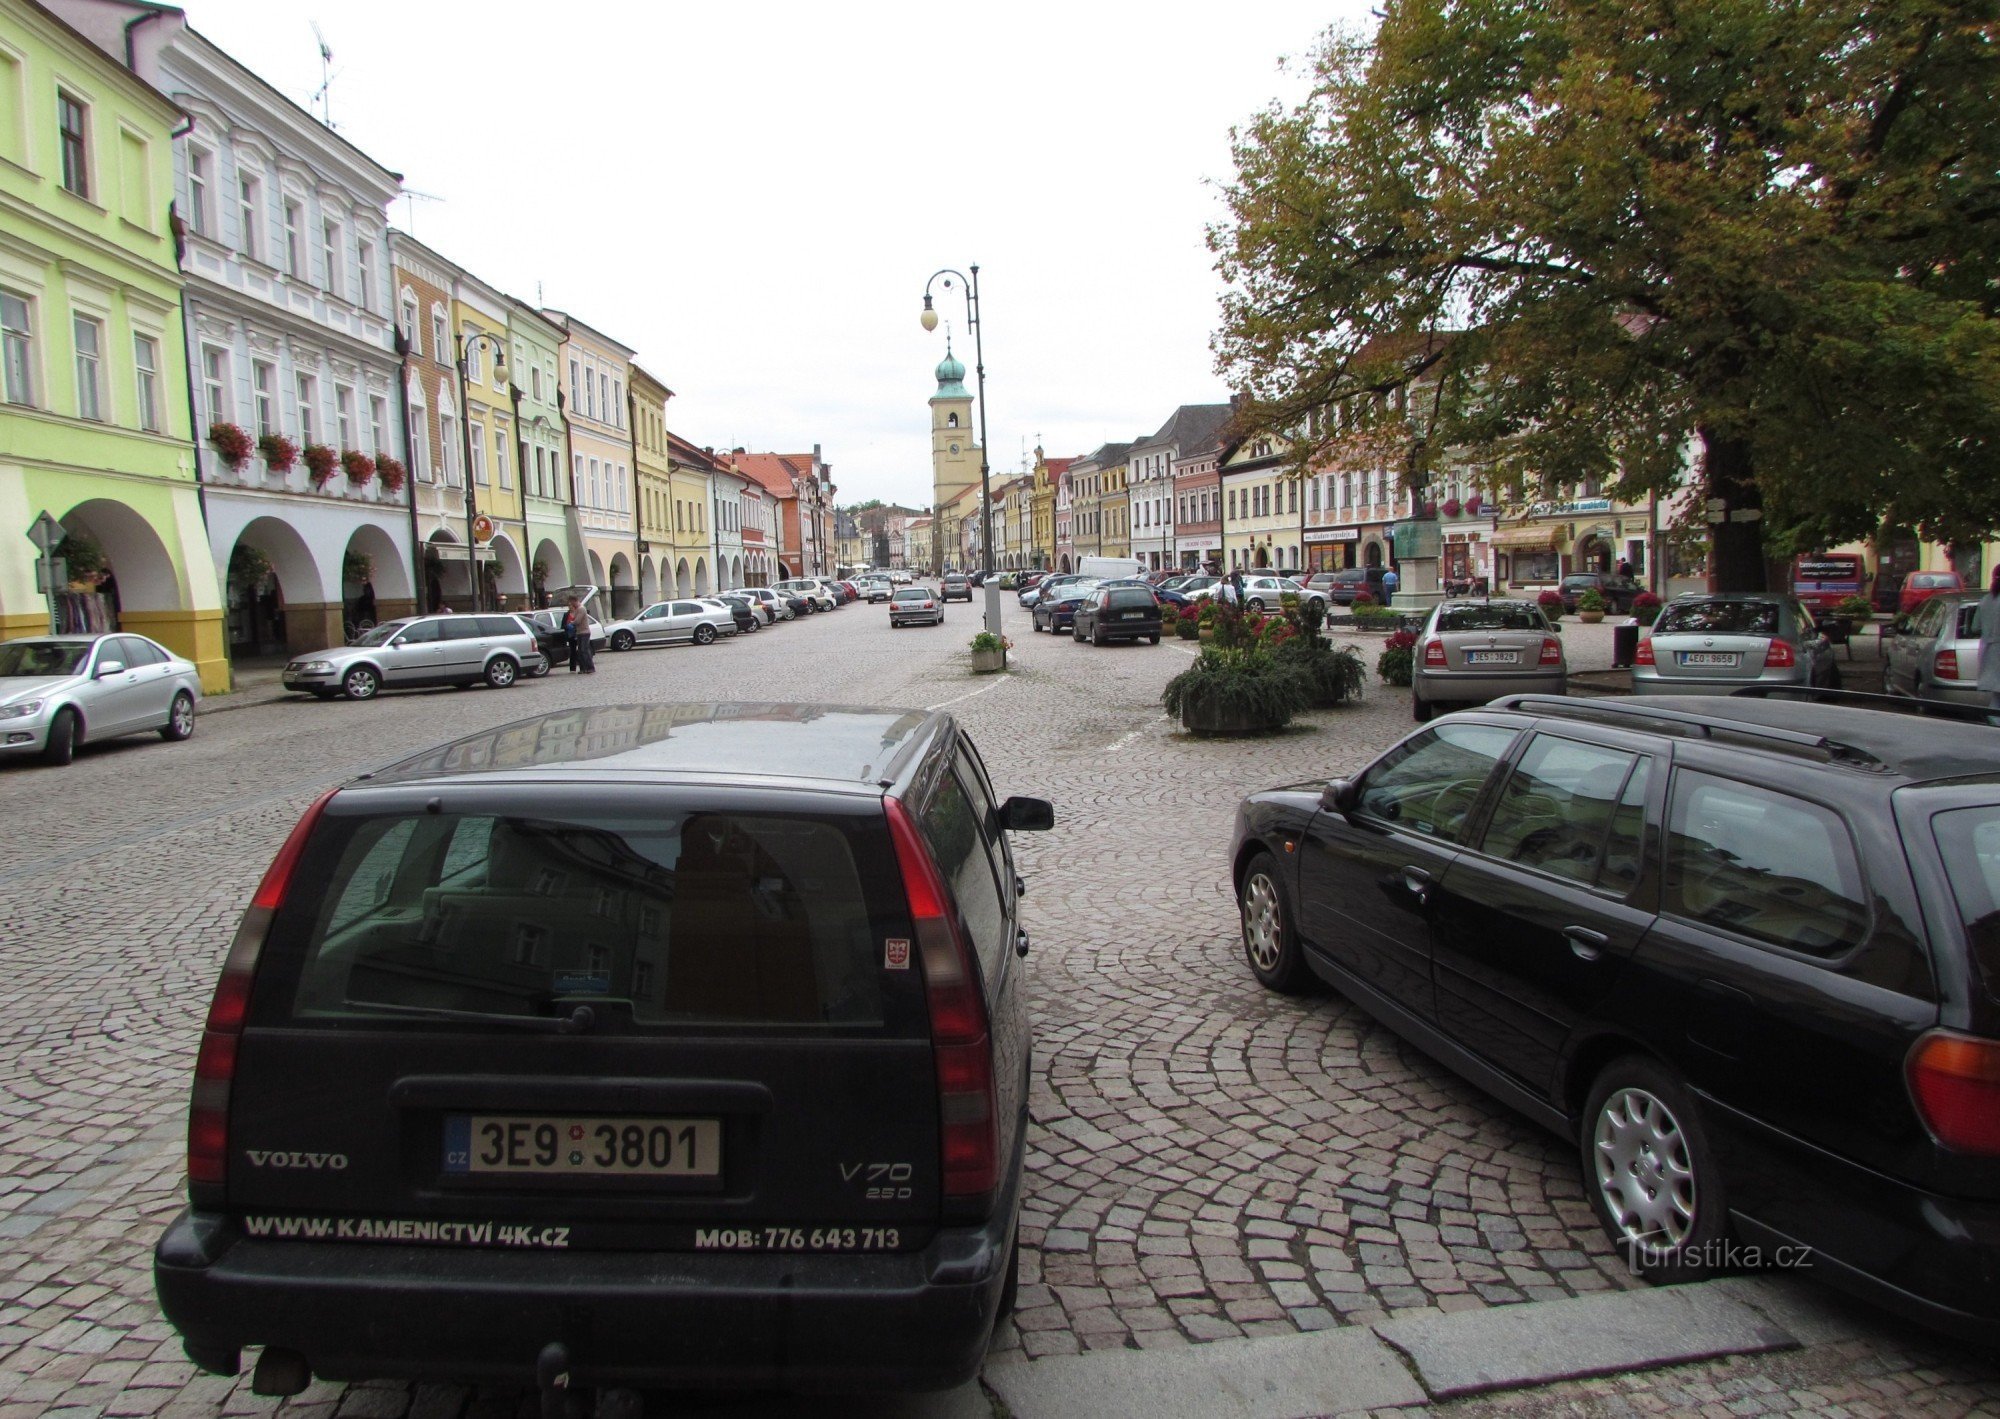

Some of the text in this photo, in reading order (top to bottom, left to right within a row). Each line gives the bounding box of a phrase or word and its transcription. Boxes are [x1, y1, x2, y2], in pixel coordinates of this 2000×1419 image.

[481, 1123, 697, 1169] 3E9 3801
[246, 1150, 348, 1169] VOLVO
[448, 1152, 467, 1164] CZ
[765, 1228, 805, 1248] 776
[810, 1228, 856, 1248] 643
[862, 1228, 900, 1248] 713
